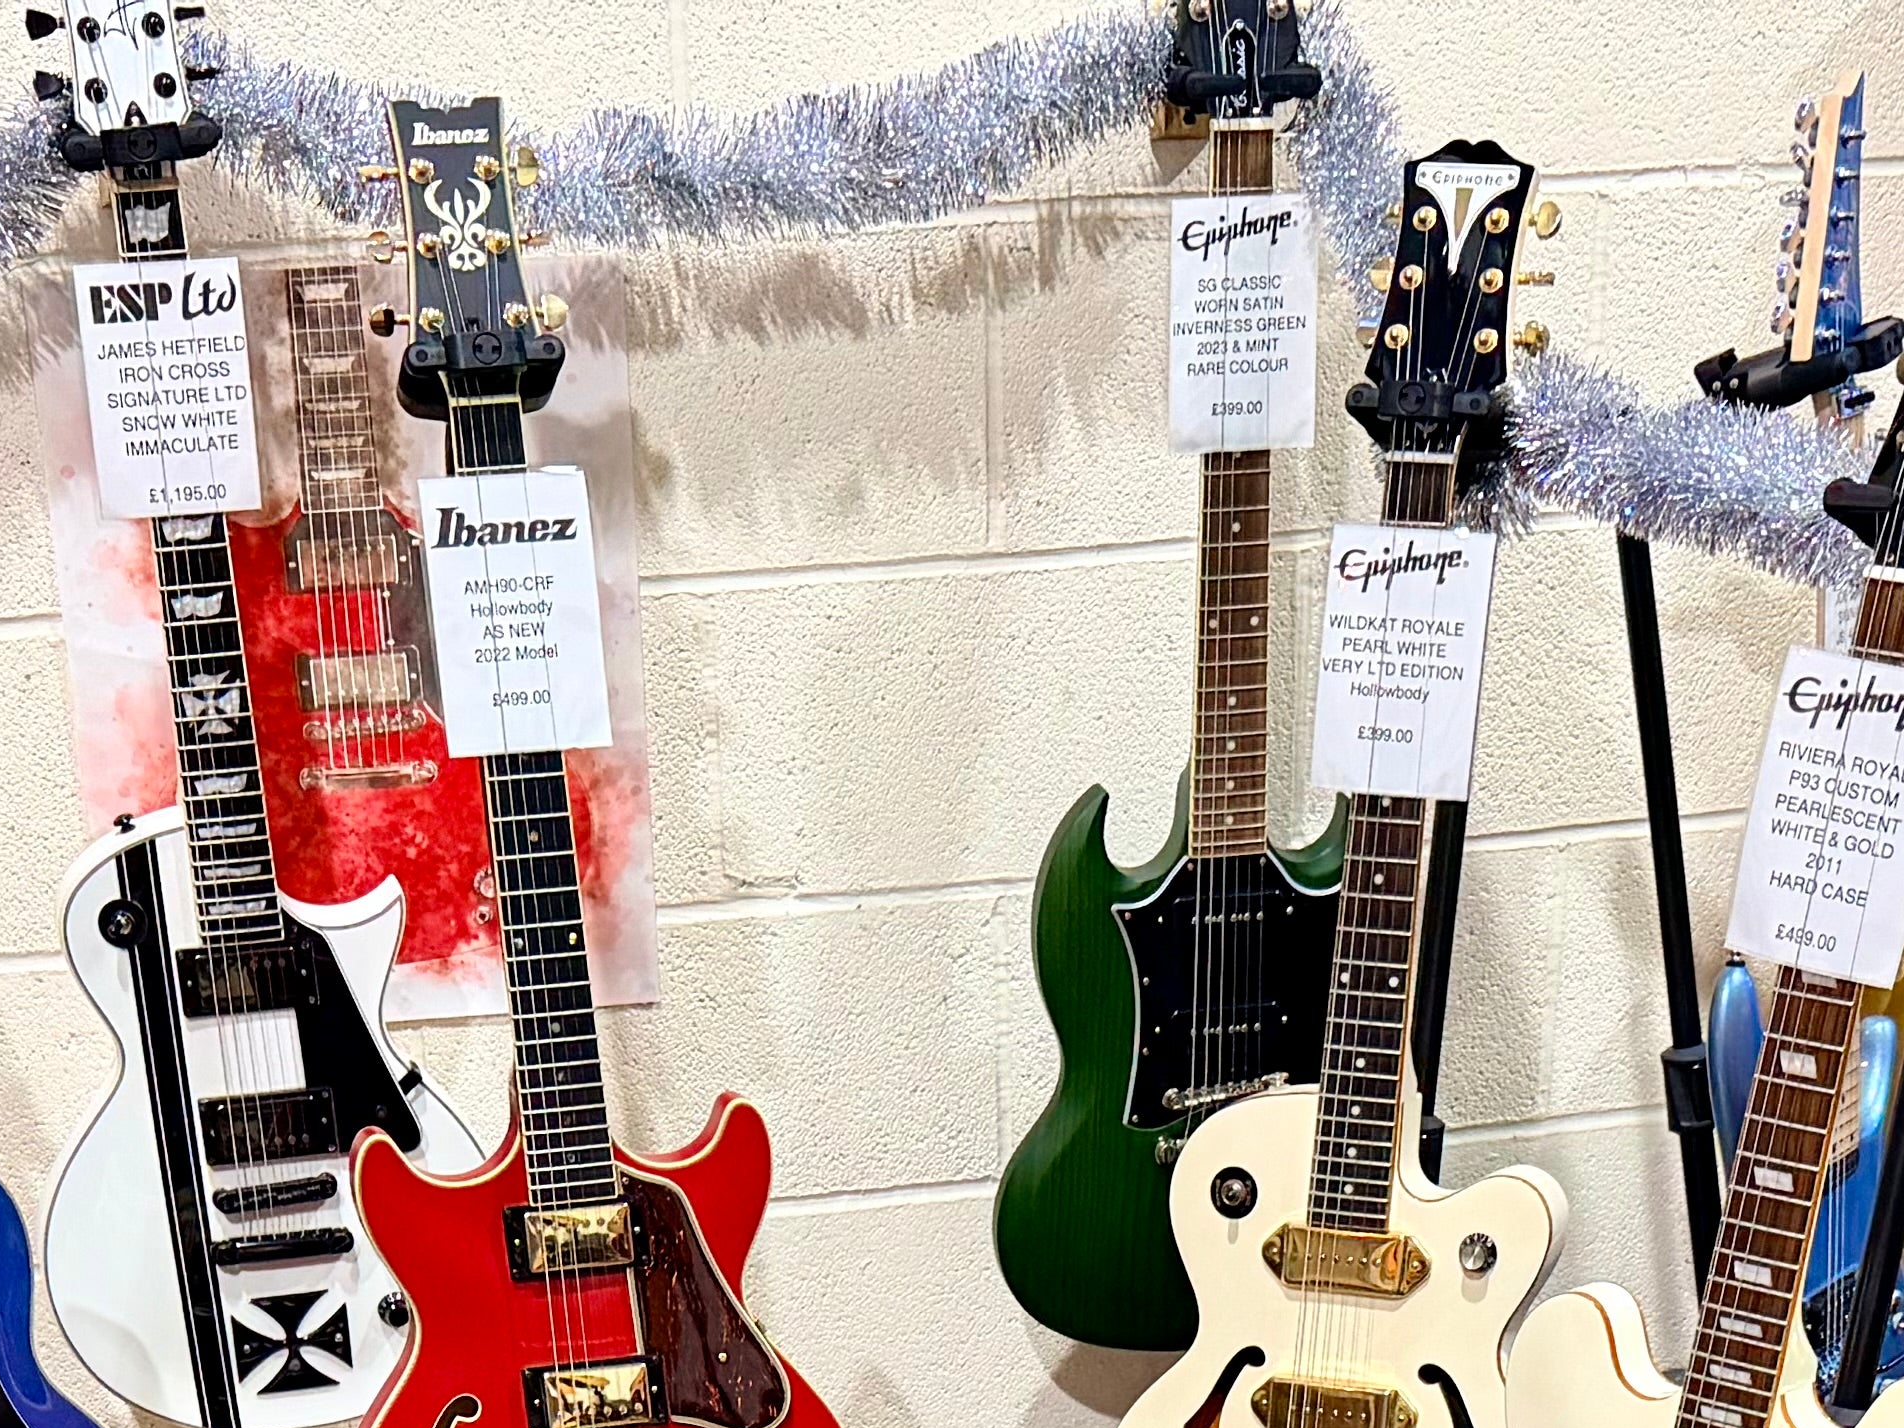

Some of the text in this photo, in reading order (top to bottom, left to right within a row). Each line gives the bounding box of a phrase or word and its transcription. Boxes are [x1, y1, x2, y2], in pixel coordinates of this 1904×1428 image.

[412, 122, 490, 146] Ibanez
[1178, 206, 1292, 261] Epiphone
[1198, 275, 1282, 293] SG CLASSIC
[89, 281, 173, 324] ESP
[1195, 296, 1284, 314] WORN SATIN
[1172, 314, 1306, 336] INVERNESS GREEN
[98, 335, 245, 360] JAMES HETFIELD
[1245, 338, 1280, 353] MINT
[119, 361, 231, 384] IRON CROSS
[1187, 357, 1289, 377] RARE COLOUR
[107, 385, 247, 409] SIGNATURE LTD
[122, 410, 238, 432] SNOW WHITE
[126, 434, 239, 457] IMMACULATE
[149, 484, 227, 504] £1,195.00
[431, 506, 578, 549] Ibanez
[1334, 540, 1463, 593] Epiphone
[471, 600, 553, 618] Hollowbody
[483, 622, 545, 640] AS NEW
[1329, 614, 1465, 637] WILDKAT ROYALE
[475, 643, 559, 663] 2022 Model
[1342, 637, 1447, 658] PEARL WHITE
[1322, 658, 1464, 681] VERY LTD EDITION
[1350, 681, 1430, 704] Hollowbody
[1357, 725, 1414, 744] £399.00
[1778, 741, 1846, 769] RIVIERA
[1788, 770, 1900, 808] P93 CUSTOM
[1775, 793, 1903, 835] PEARLESCENT
[1770, 819, 1895, 860] WHITE & GOLD
[1805, 852, 1843, 876] 2011
[1769, 870, 1868, 908] HARD CASE
